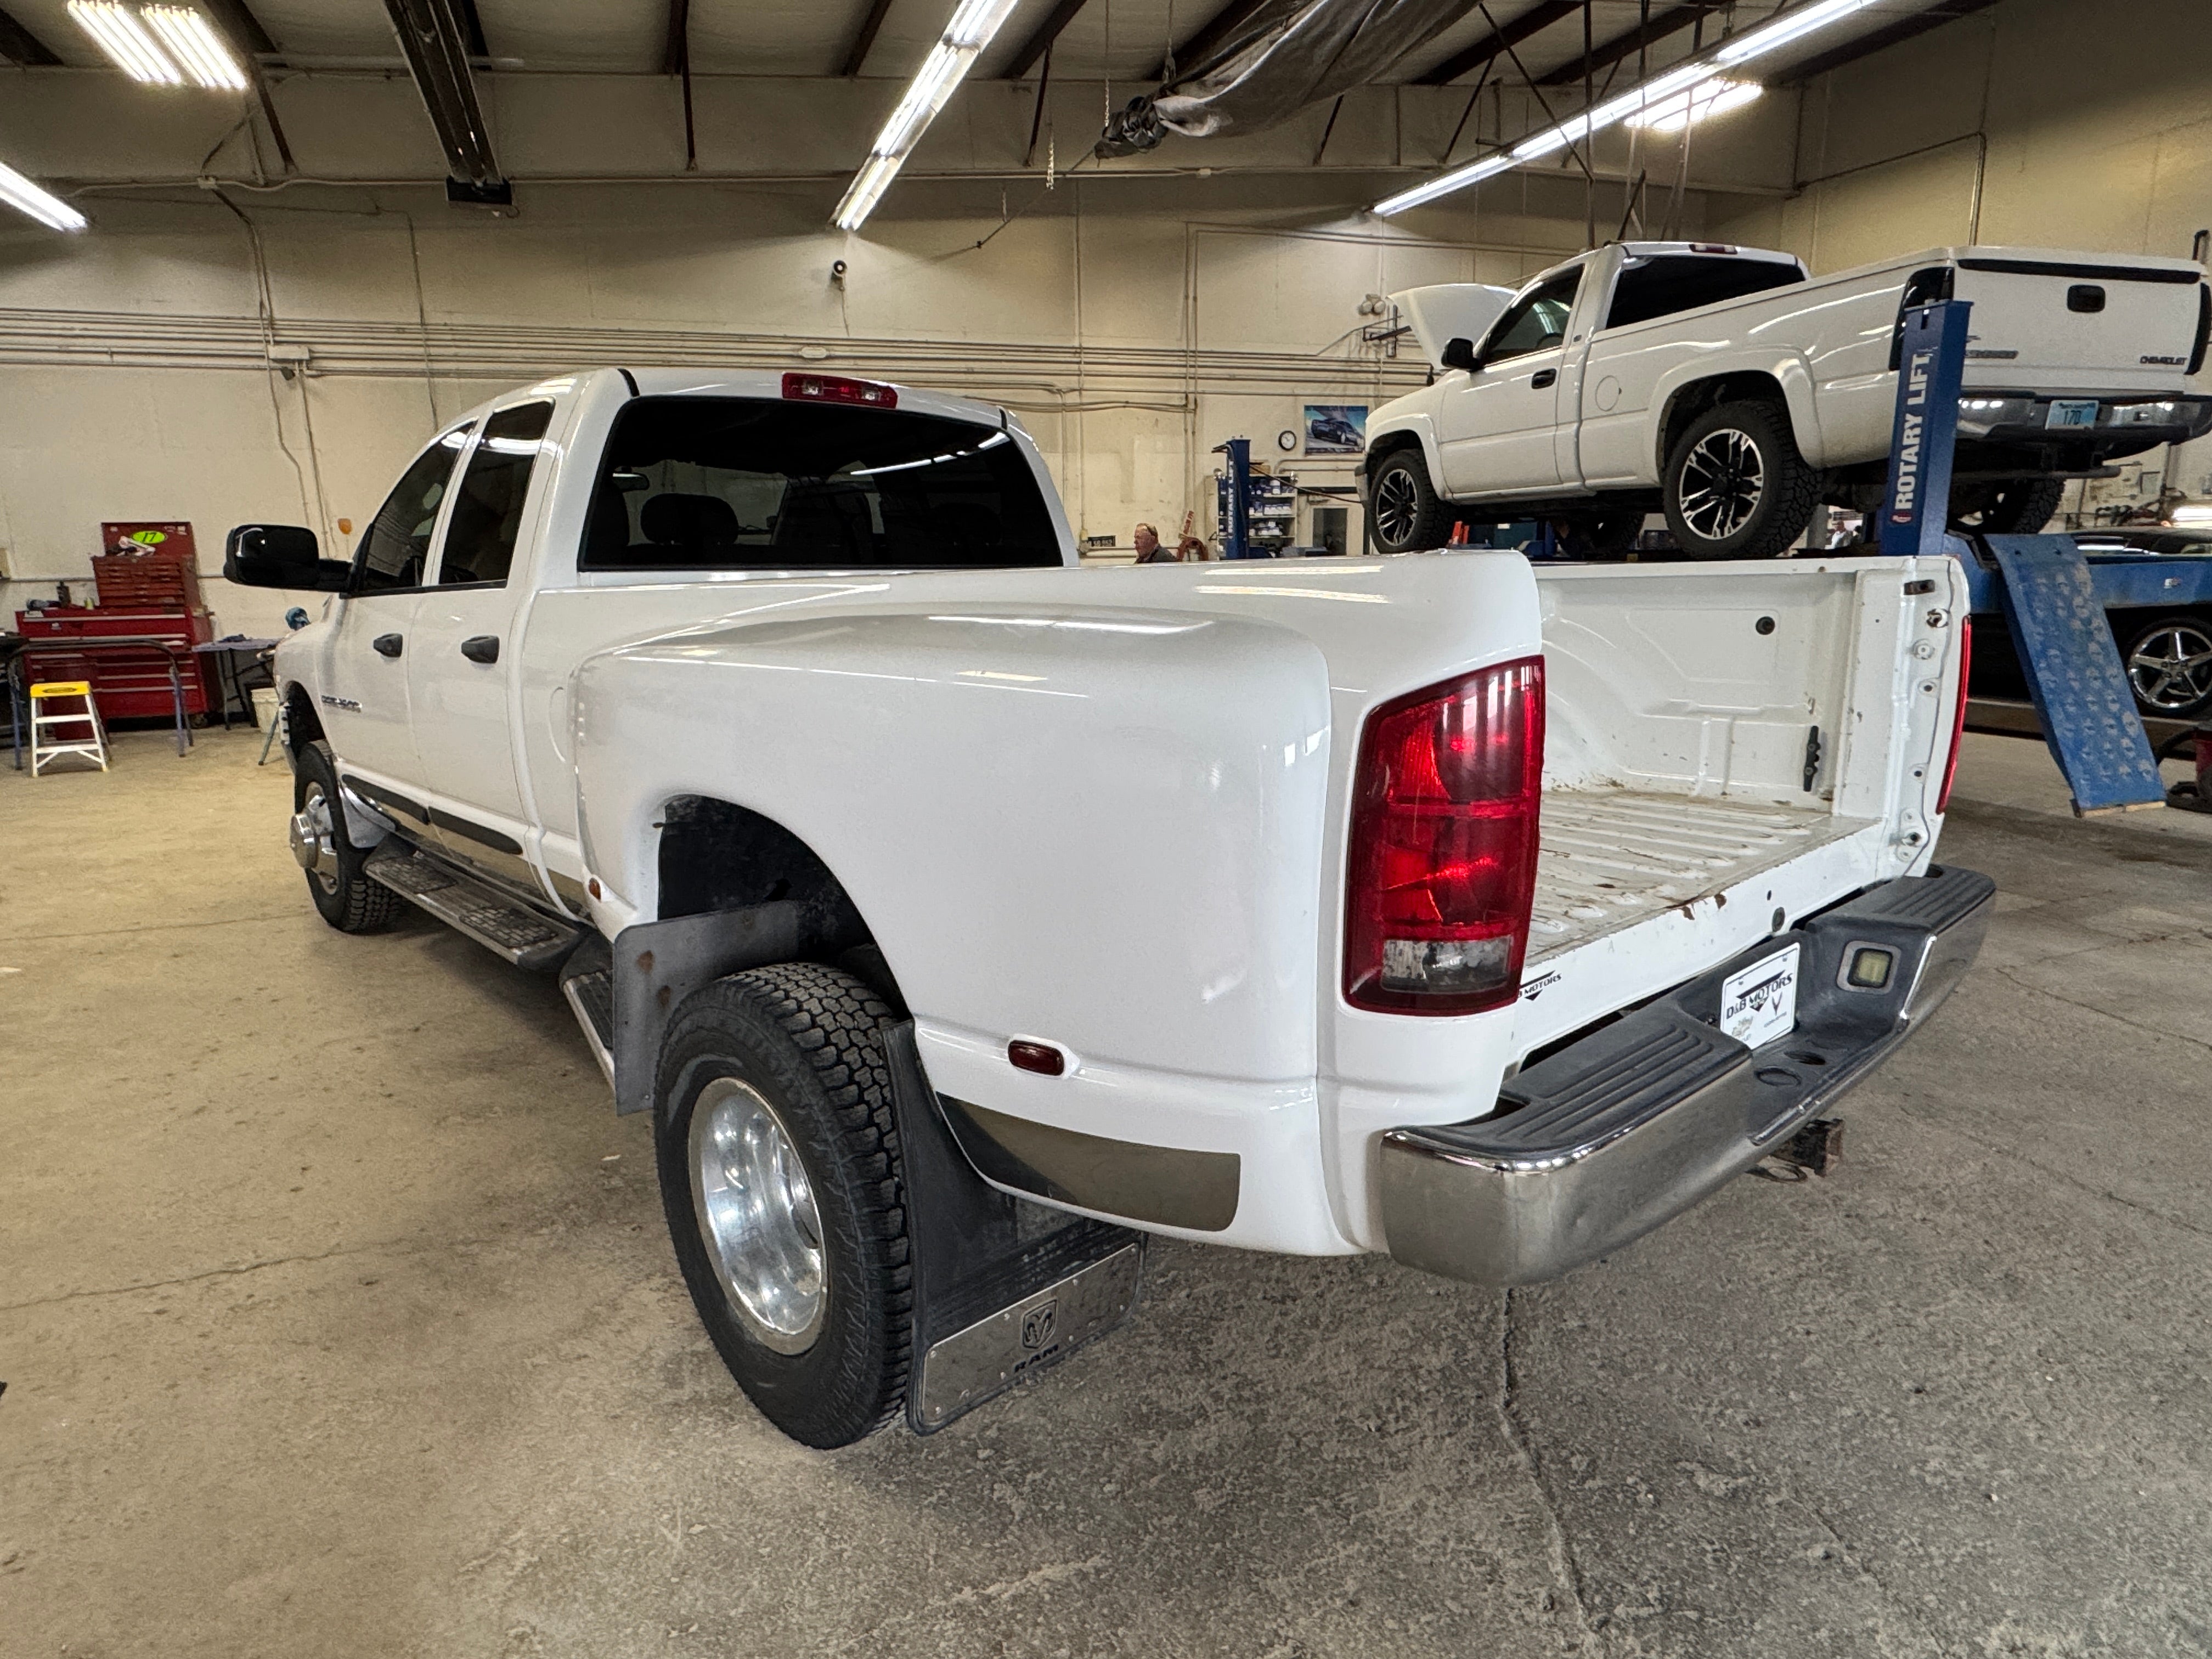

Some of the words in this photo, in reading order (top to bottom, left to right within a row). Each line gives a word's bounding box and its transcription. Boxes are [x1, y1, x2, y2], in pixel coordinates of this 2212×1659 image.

[1907, 354, 1930, 405] LIFT
[1895, 413, 1923, 509] ROTARY
[142, 532, 157, 542] 17
[1524, 973, 1562, 995] MOTORS
[1749, 972, 1793, 1004] MOTORS
[1014, 1345, 1059, 1373] RAM
